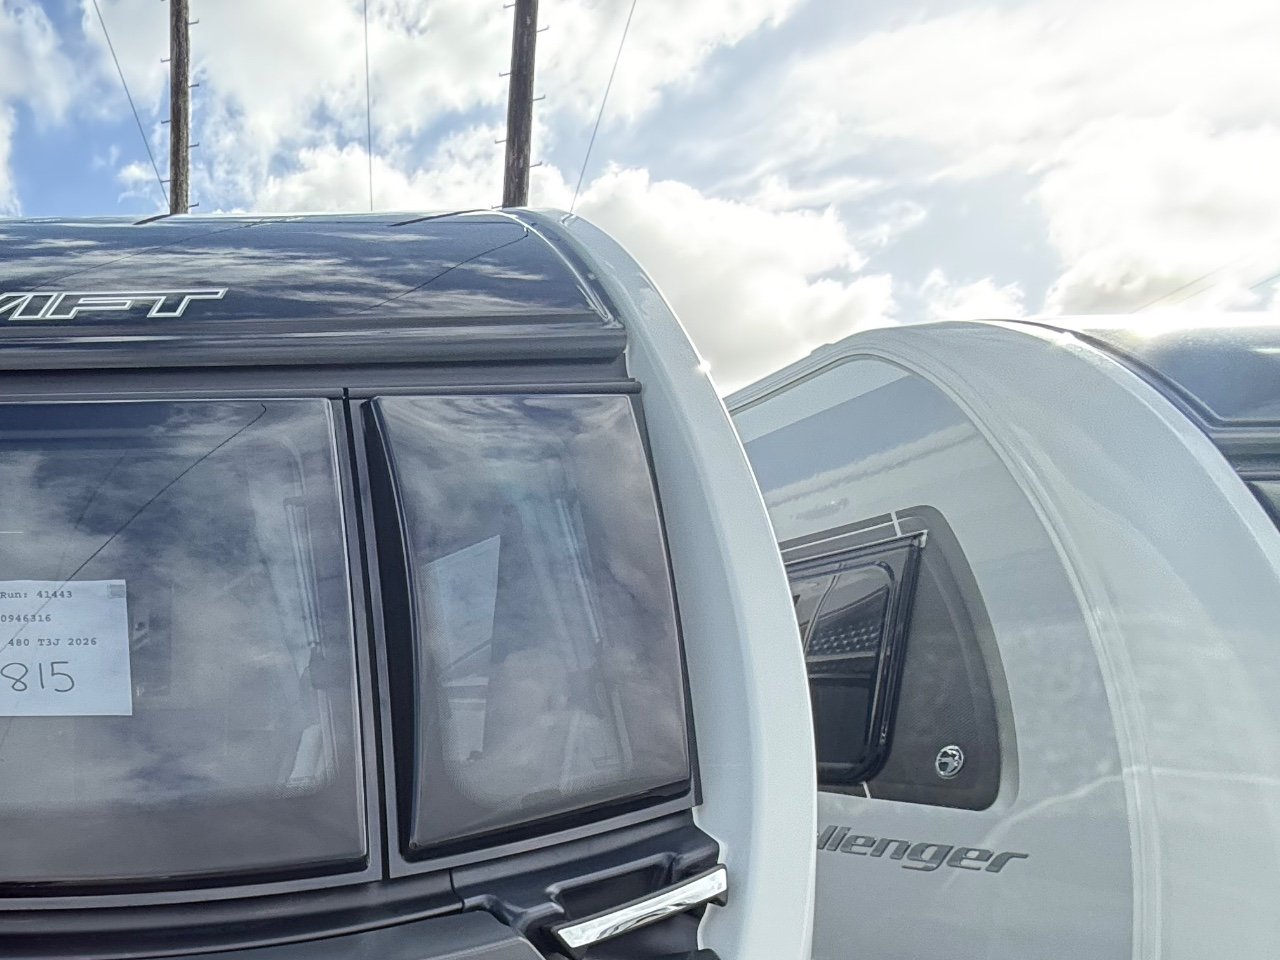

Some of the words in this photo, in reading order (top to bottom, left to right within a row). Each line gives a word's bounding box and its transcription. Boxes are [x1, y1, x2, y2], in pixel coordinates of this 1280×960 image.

[0, 591, 29, 599] Run:
[36, 590, 73, 599] 41443
[7, 639, 30, 647] 480
[37, 638, 60, 647] T3J
[67, 637, 97, 646] 2026
[0, 661, 75, 693] 815
[816, 824, 1030, 873] llenger
